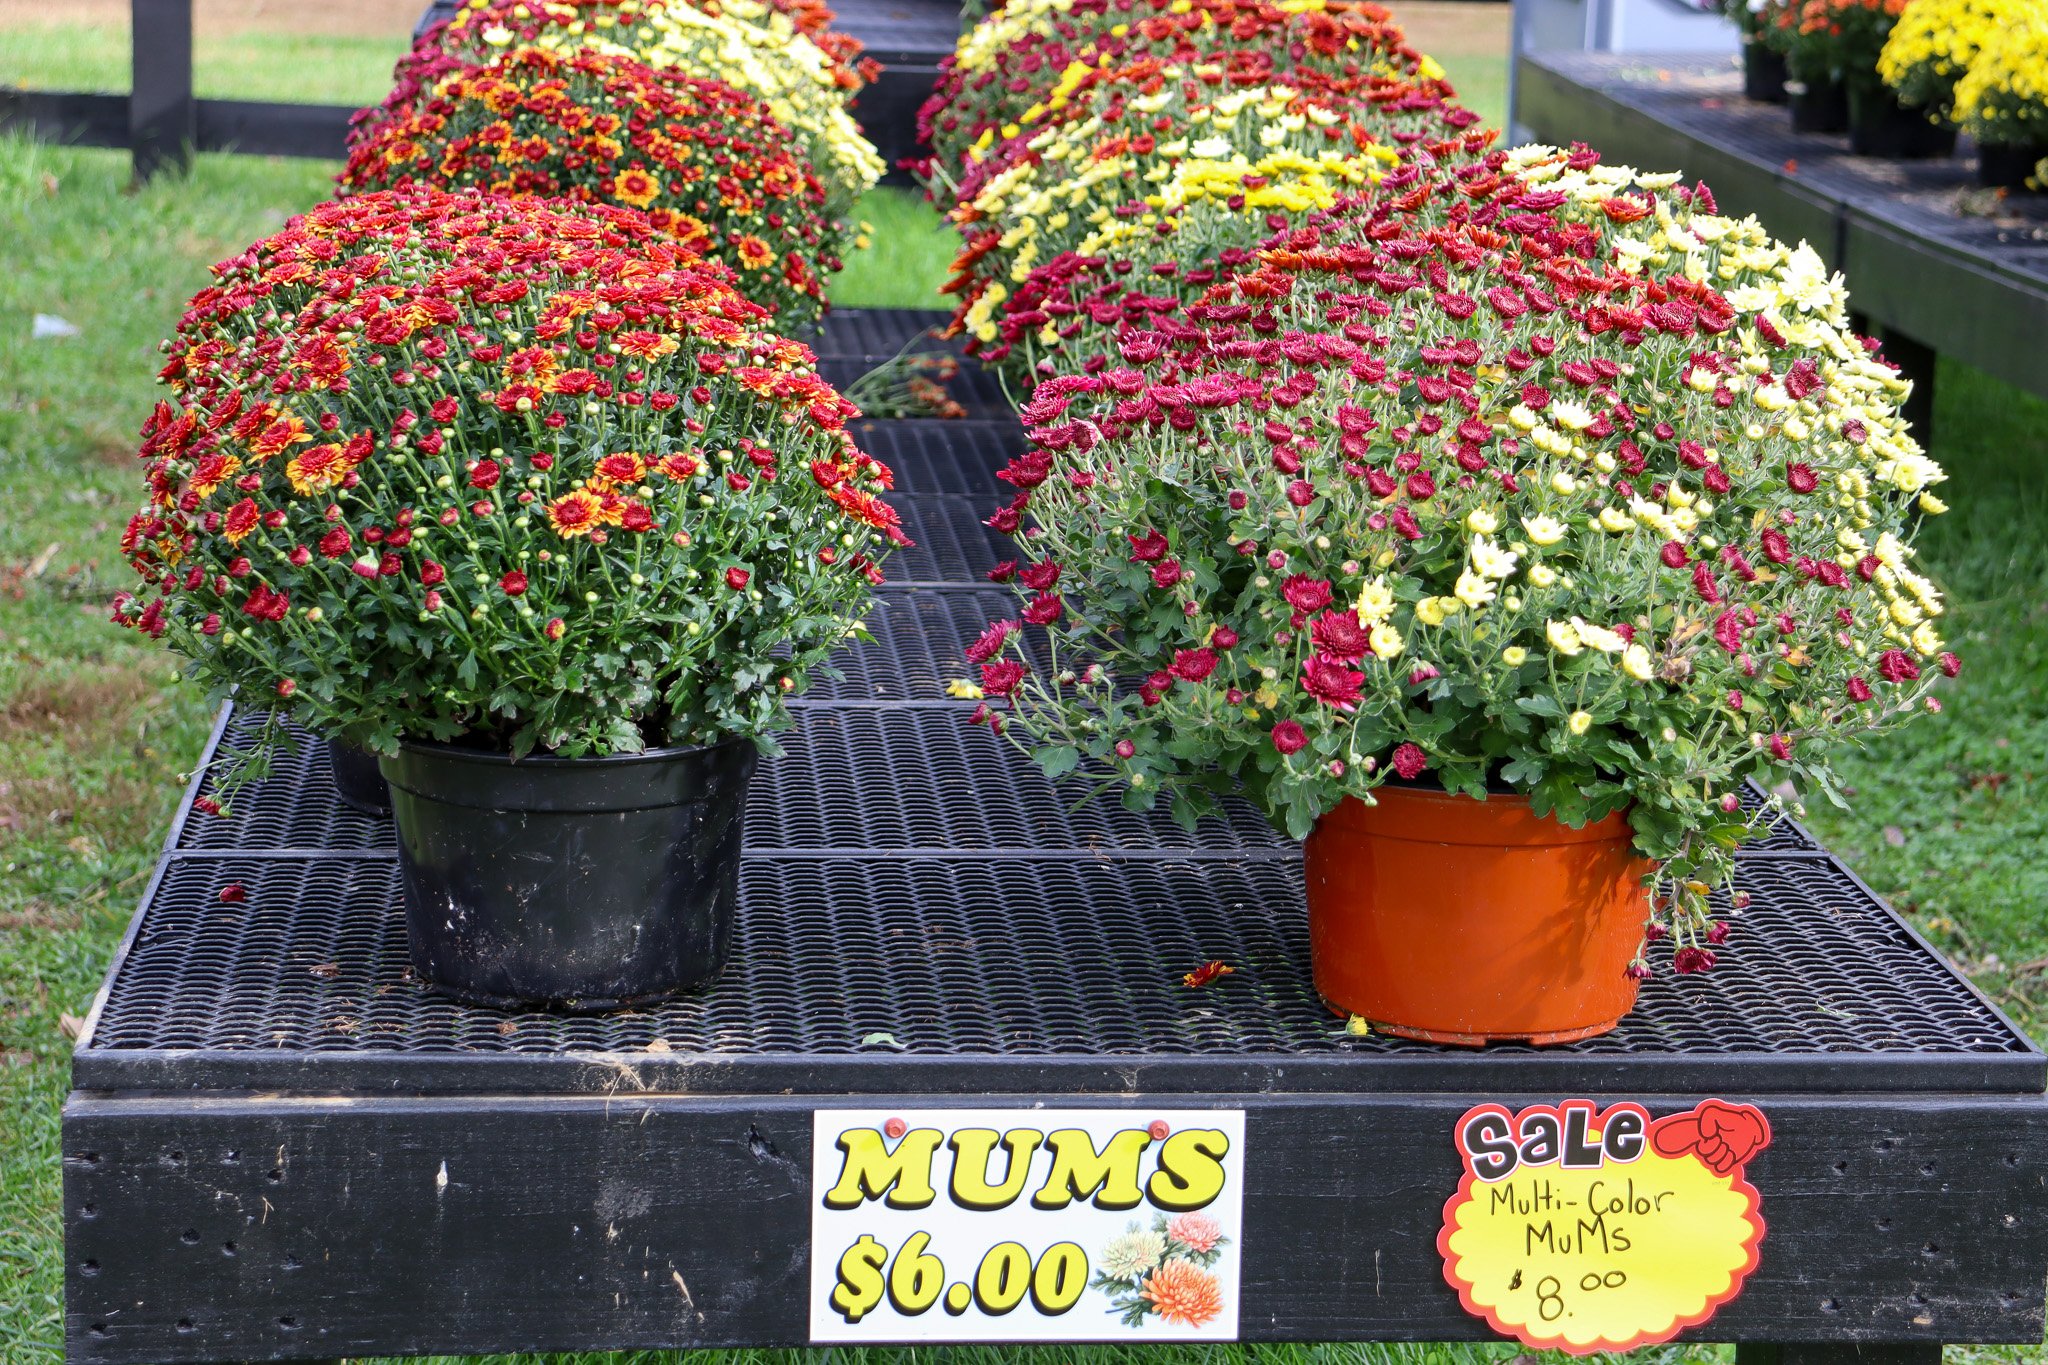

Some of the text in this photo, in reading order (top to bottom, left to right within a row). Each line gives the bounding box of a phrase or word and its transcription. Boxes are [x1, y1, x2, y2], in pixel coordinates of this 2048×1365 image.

[822, 1128, 1230, 1211] MUMS
[1490, 1177, 1675, 1216] Multi-Color
[829, 1230, 1089, 1324] $6.00
